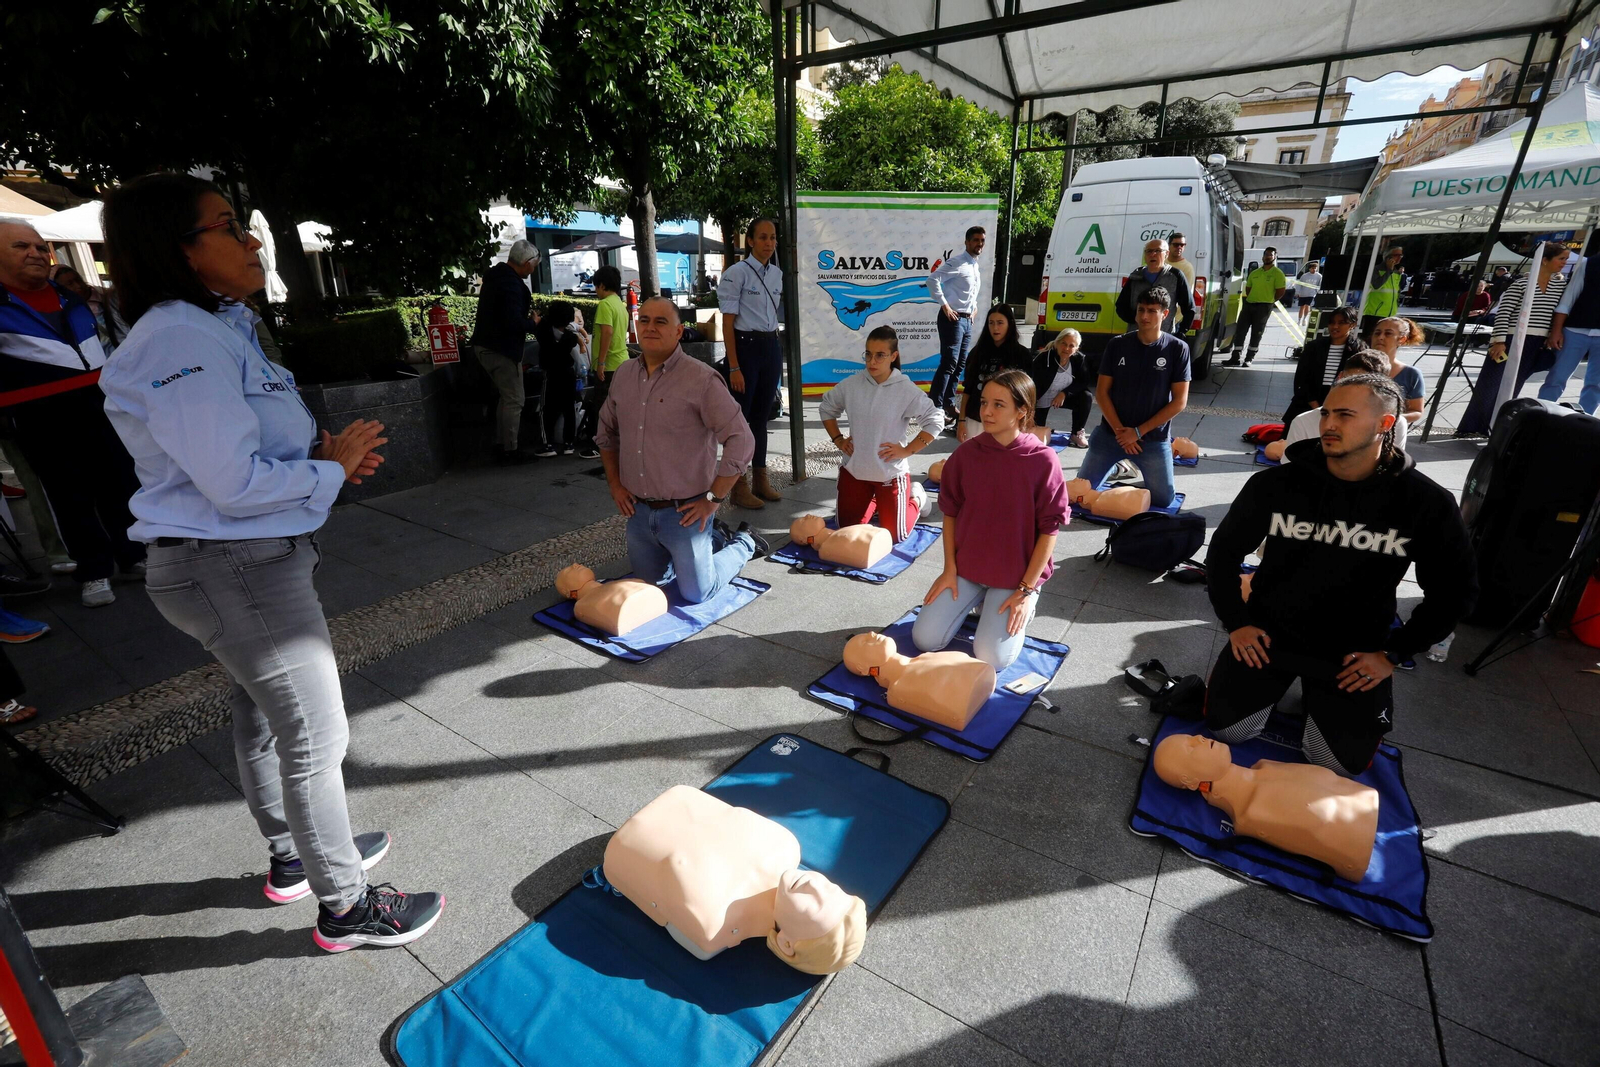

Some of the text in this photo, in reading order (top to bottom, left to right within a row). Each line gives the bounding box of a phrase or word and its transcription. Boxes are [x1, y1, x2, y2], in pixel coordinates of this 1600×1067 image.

[1411, 165, 1600, 198] PUESTO MAND
[1064, 265, 1113, 274] de Andalucía
[1061, 311, 1096, 320] 9298 LFZ
[434, 352, 458, 361] EXTINTOR
